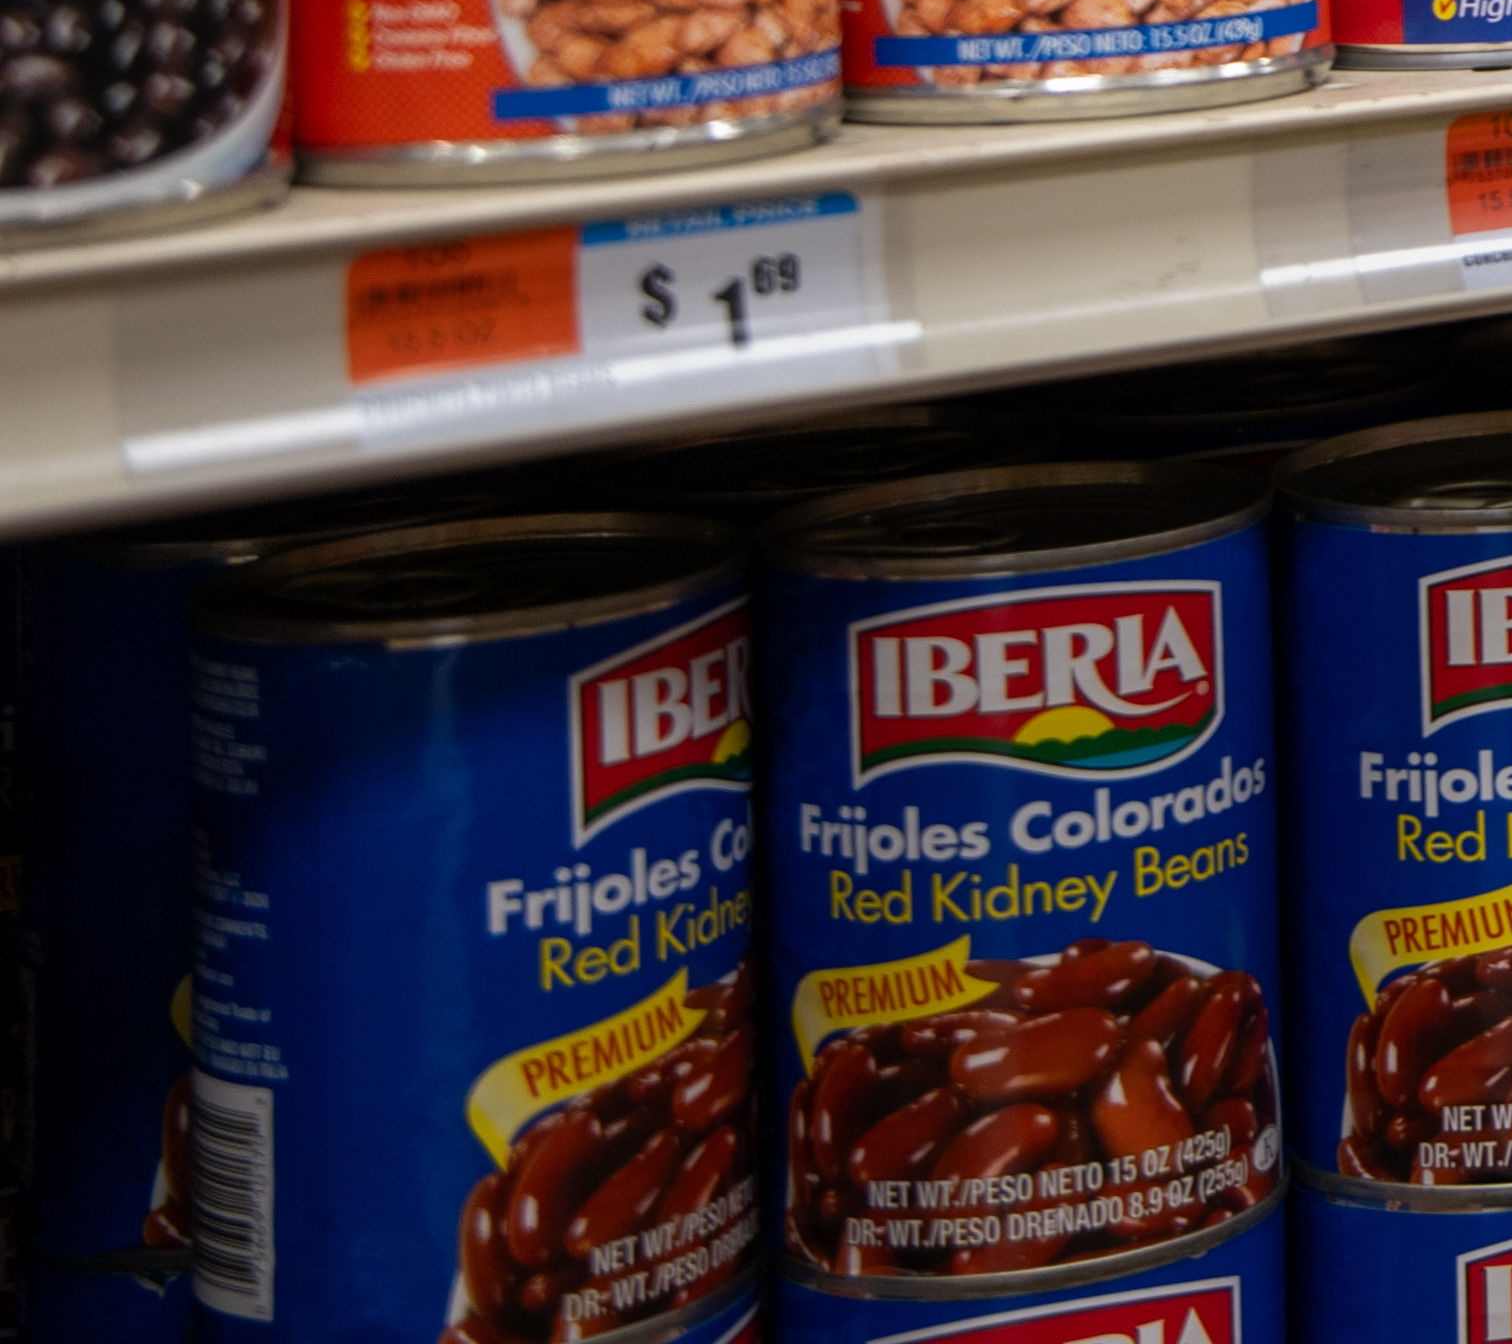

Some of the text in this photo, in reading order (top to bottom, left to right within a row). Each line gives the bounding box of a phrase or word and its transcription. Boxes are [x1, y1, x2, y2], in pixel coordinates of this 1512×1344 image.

[870, 601, 1211, 721] IBERIA
[799, 754, 1269, 876] Frijoles Colorados
[829, 831, 1253, 931] Red Kidney Beans
[519, 994, 686, 1101] PREMIUM
